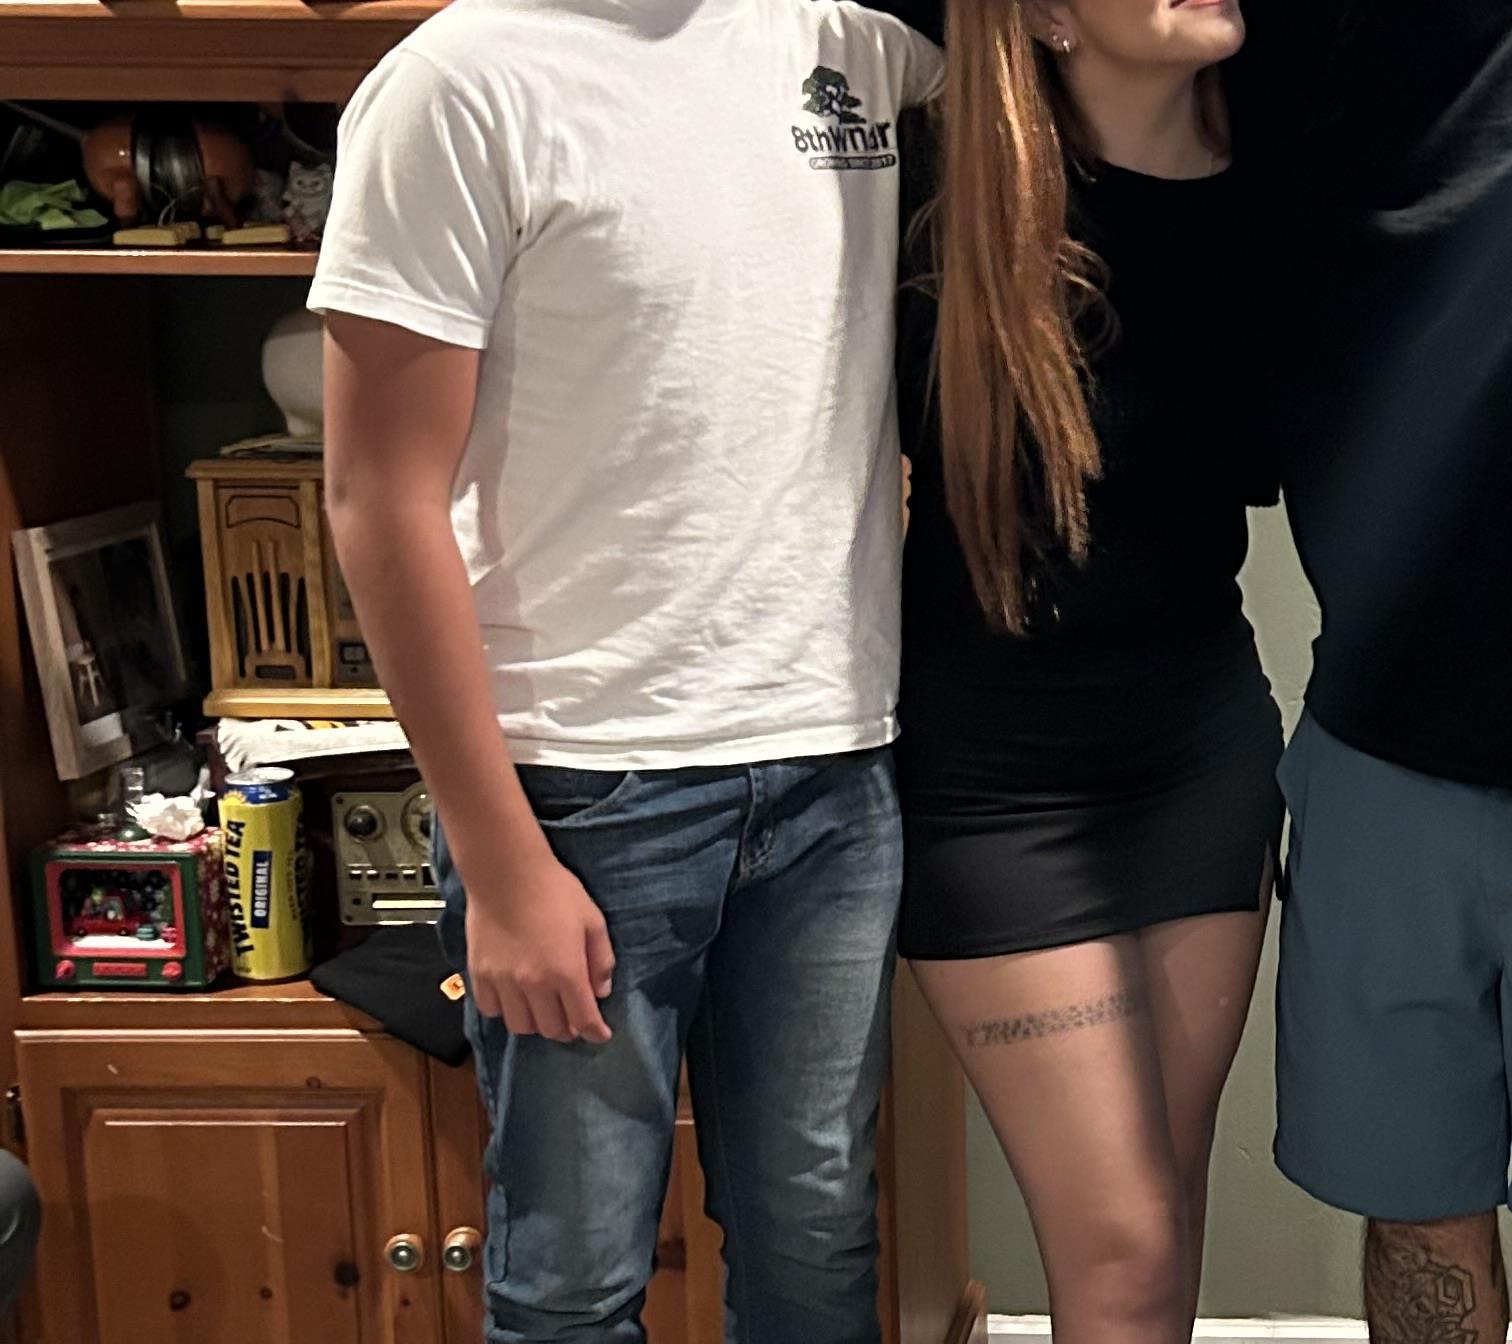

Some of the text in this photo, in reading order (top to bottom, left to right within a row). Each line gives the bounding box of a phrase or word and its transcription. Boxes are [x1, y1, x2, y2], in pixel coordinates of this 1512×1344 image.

[225, 820, 246, 858] TEA
[225, 862, 255, 956] TWISTED
[253, 861, 270, 918] ORIGINAL
